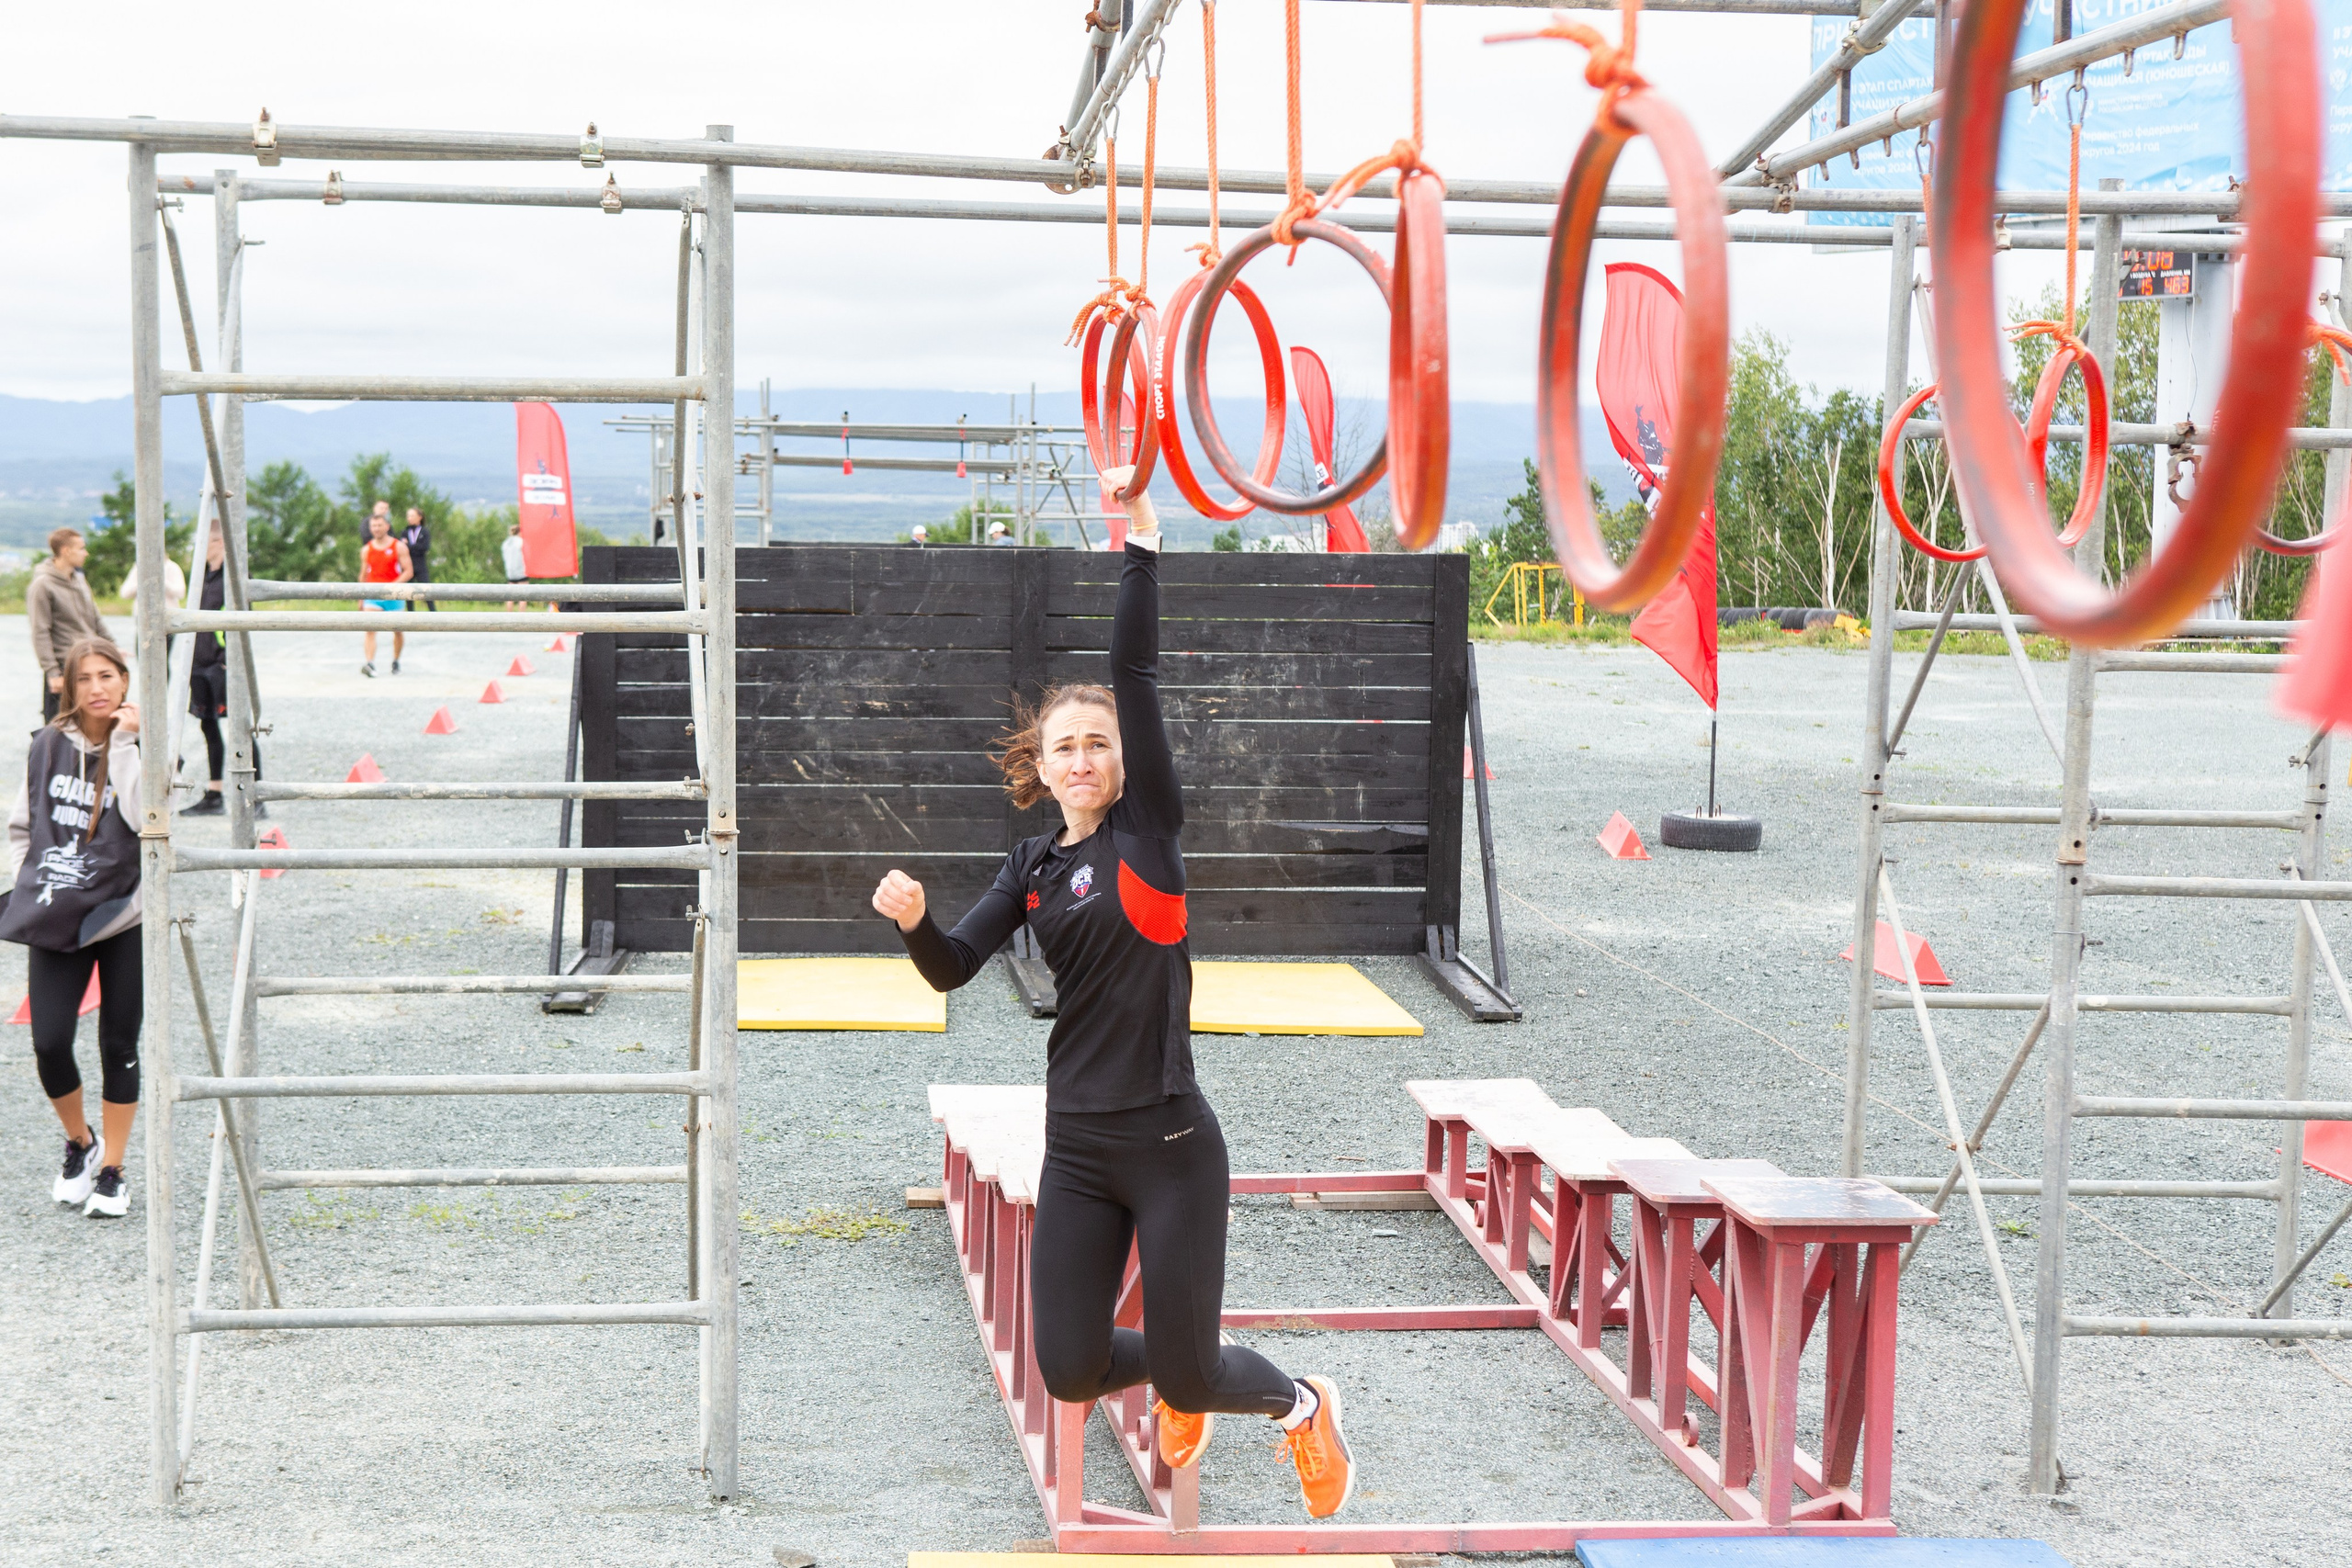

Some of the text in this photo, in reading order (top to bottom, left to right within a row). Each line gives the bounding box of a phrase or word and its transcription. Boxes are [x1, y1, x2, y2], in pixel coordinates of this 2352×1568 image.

[1860, 80, 1885, 95] ЭТАП
[2116, 141, 2141, 154] 2024
[2143, 141, 2159, 154] год
[1154, 383, 1165, 420] СПОРТ
[51, 804, 91, 830] JUDG
